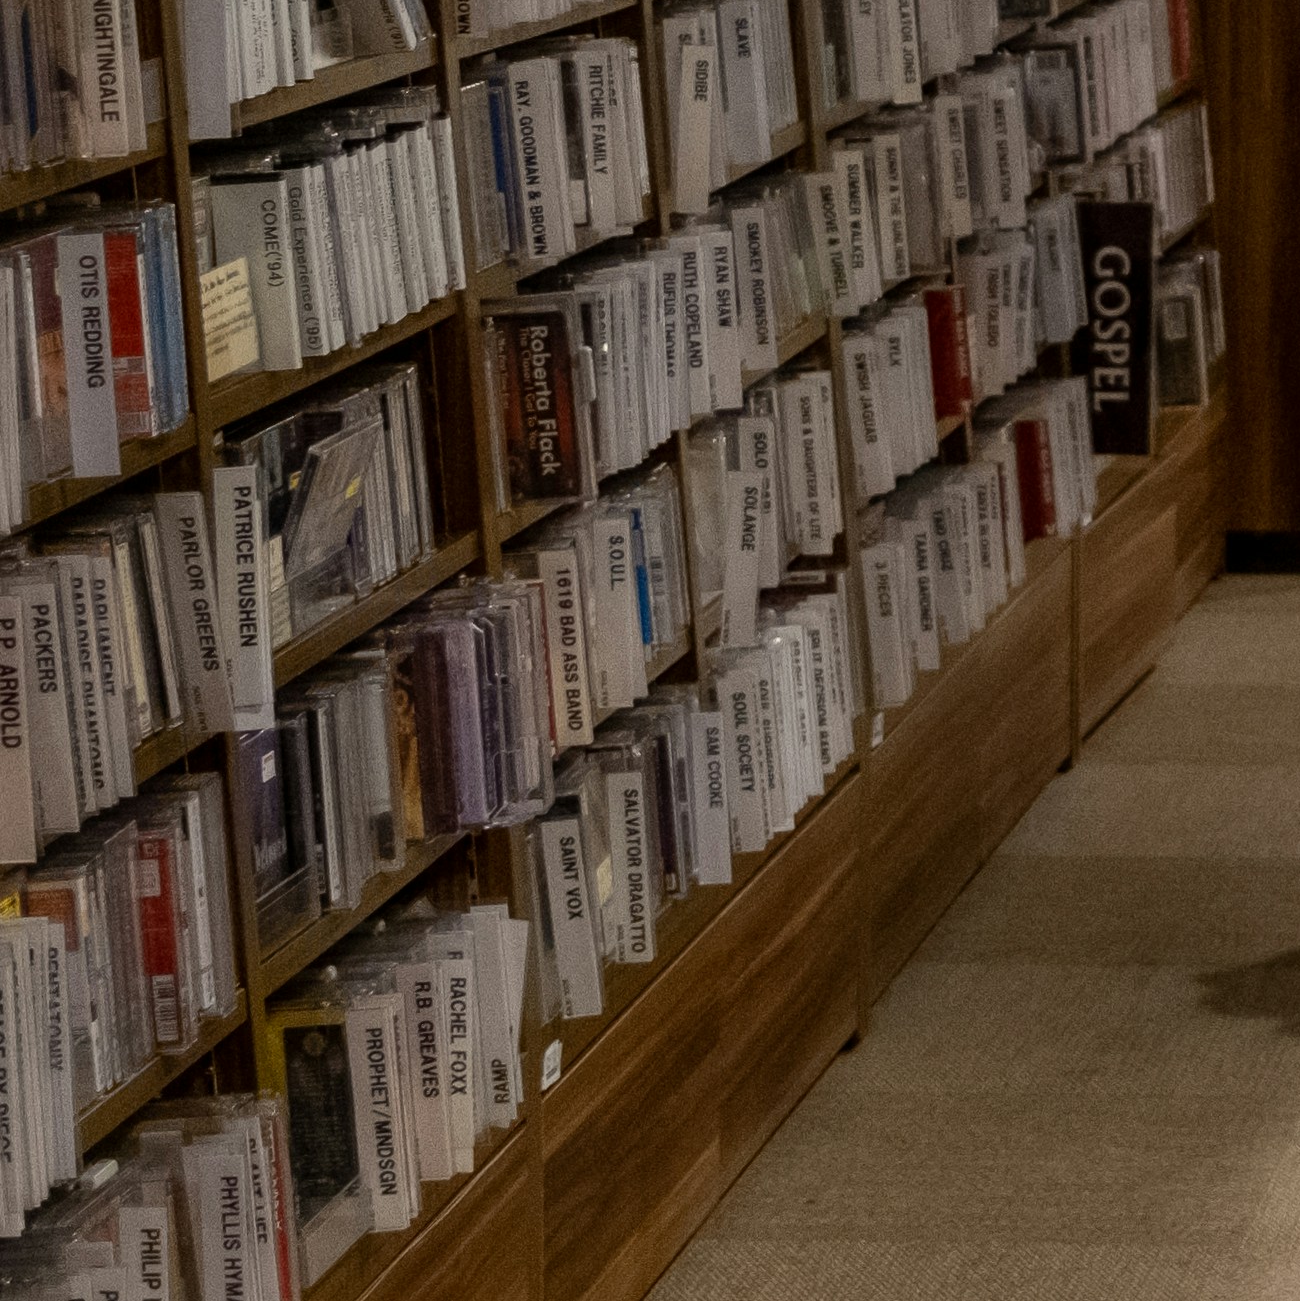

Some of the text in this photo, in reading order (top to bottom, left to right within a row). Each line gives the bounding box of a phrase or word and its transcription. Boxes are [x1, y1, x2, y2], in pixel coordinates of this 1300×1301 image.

[735, 17, 752, 58] SLAVE
[902, 47, 917, 84] JONES
[588, 64, 609, 176] RITCHIE FAMILY
[694, 60, 709, 103] SIDIBE
[287, 186, 307, 222] Gold
[886, 147, 900, 181] SUNNY
[828, 237, 842, 247] &
[846, 163, 866, 270] SUMMER WALKER
[890, 196, 902, 216] THE
[293, 227, 315, 312] Experience
[663, 272, 680, 316] RUFUS
[683, 251, 704, 369] RUTH COPELAND
[713, 246, 733, 328] RYAN SHAW
[746, 222, 770, 346] SMOKEY ROBINSON
[78, 255, 107, 389] OTIS REDDING
[888, 337, 902, 368] SYLK
[1092, 245, 1132, 412] GOSPEL
[529, 324, 562, 476] Roberta Flack
[854, 352, 878, 444] SWISH JAGUAR
[753, 432, 769, 469] SOLO
[741, 485, 759, 552] SOLANGE
[807, 501, 820, 515] OF
[179, 516, 205, 591] PARLOR
[234, 485, 259, 649] PATRICE RUSHEN
[913, 532, 934, 633] TAANA GARDNER
[191, 597, 220, 672] GREENS
[877, 574, 894, 618] PIECES
[30, 604, 58, 694] PACKERS
[555, 568, 585, 732] 1619 BAD ASS BAND
[705, 726, 725, 810] SAM COOKE
[732, 691, 756, 793] SOUL SOCIETY
[559, 836, 585, 921] SAINT VOX
[623, 788, 648, 954] SALVATOR DRAGATTO
[417, 1020, 440, 1098] GREAVES
[450, 976, 468, 1096] RACHEL FOXX
[365, 1027, 398, 1196] PROPHET/MNDSGN
[220, 1175, 242, 1251] PHYLLIS
[140, 1227, 162, 1291] PHILIP
